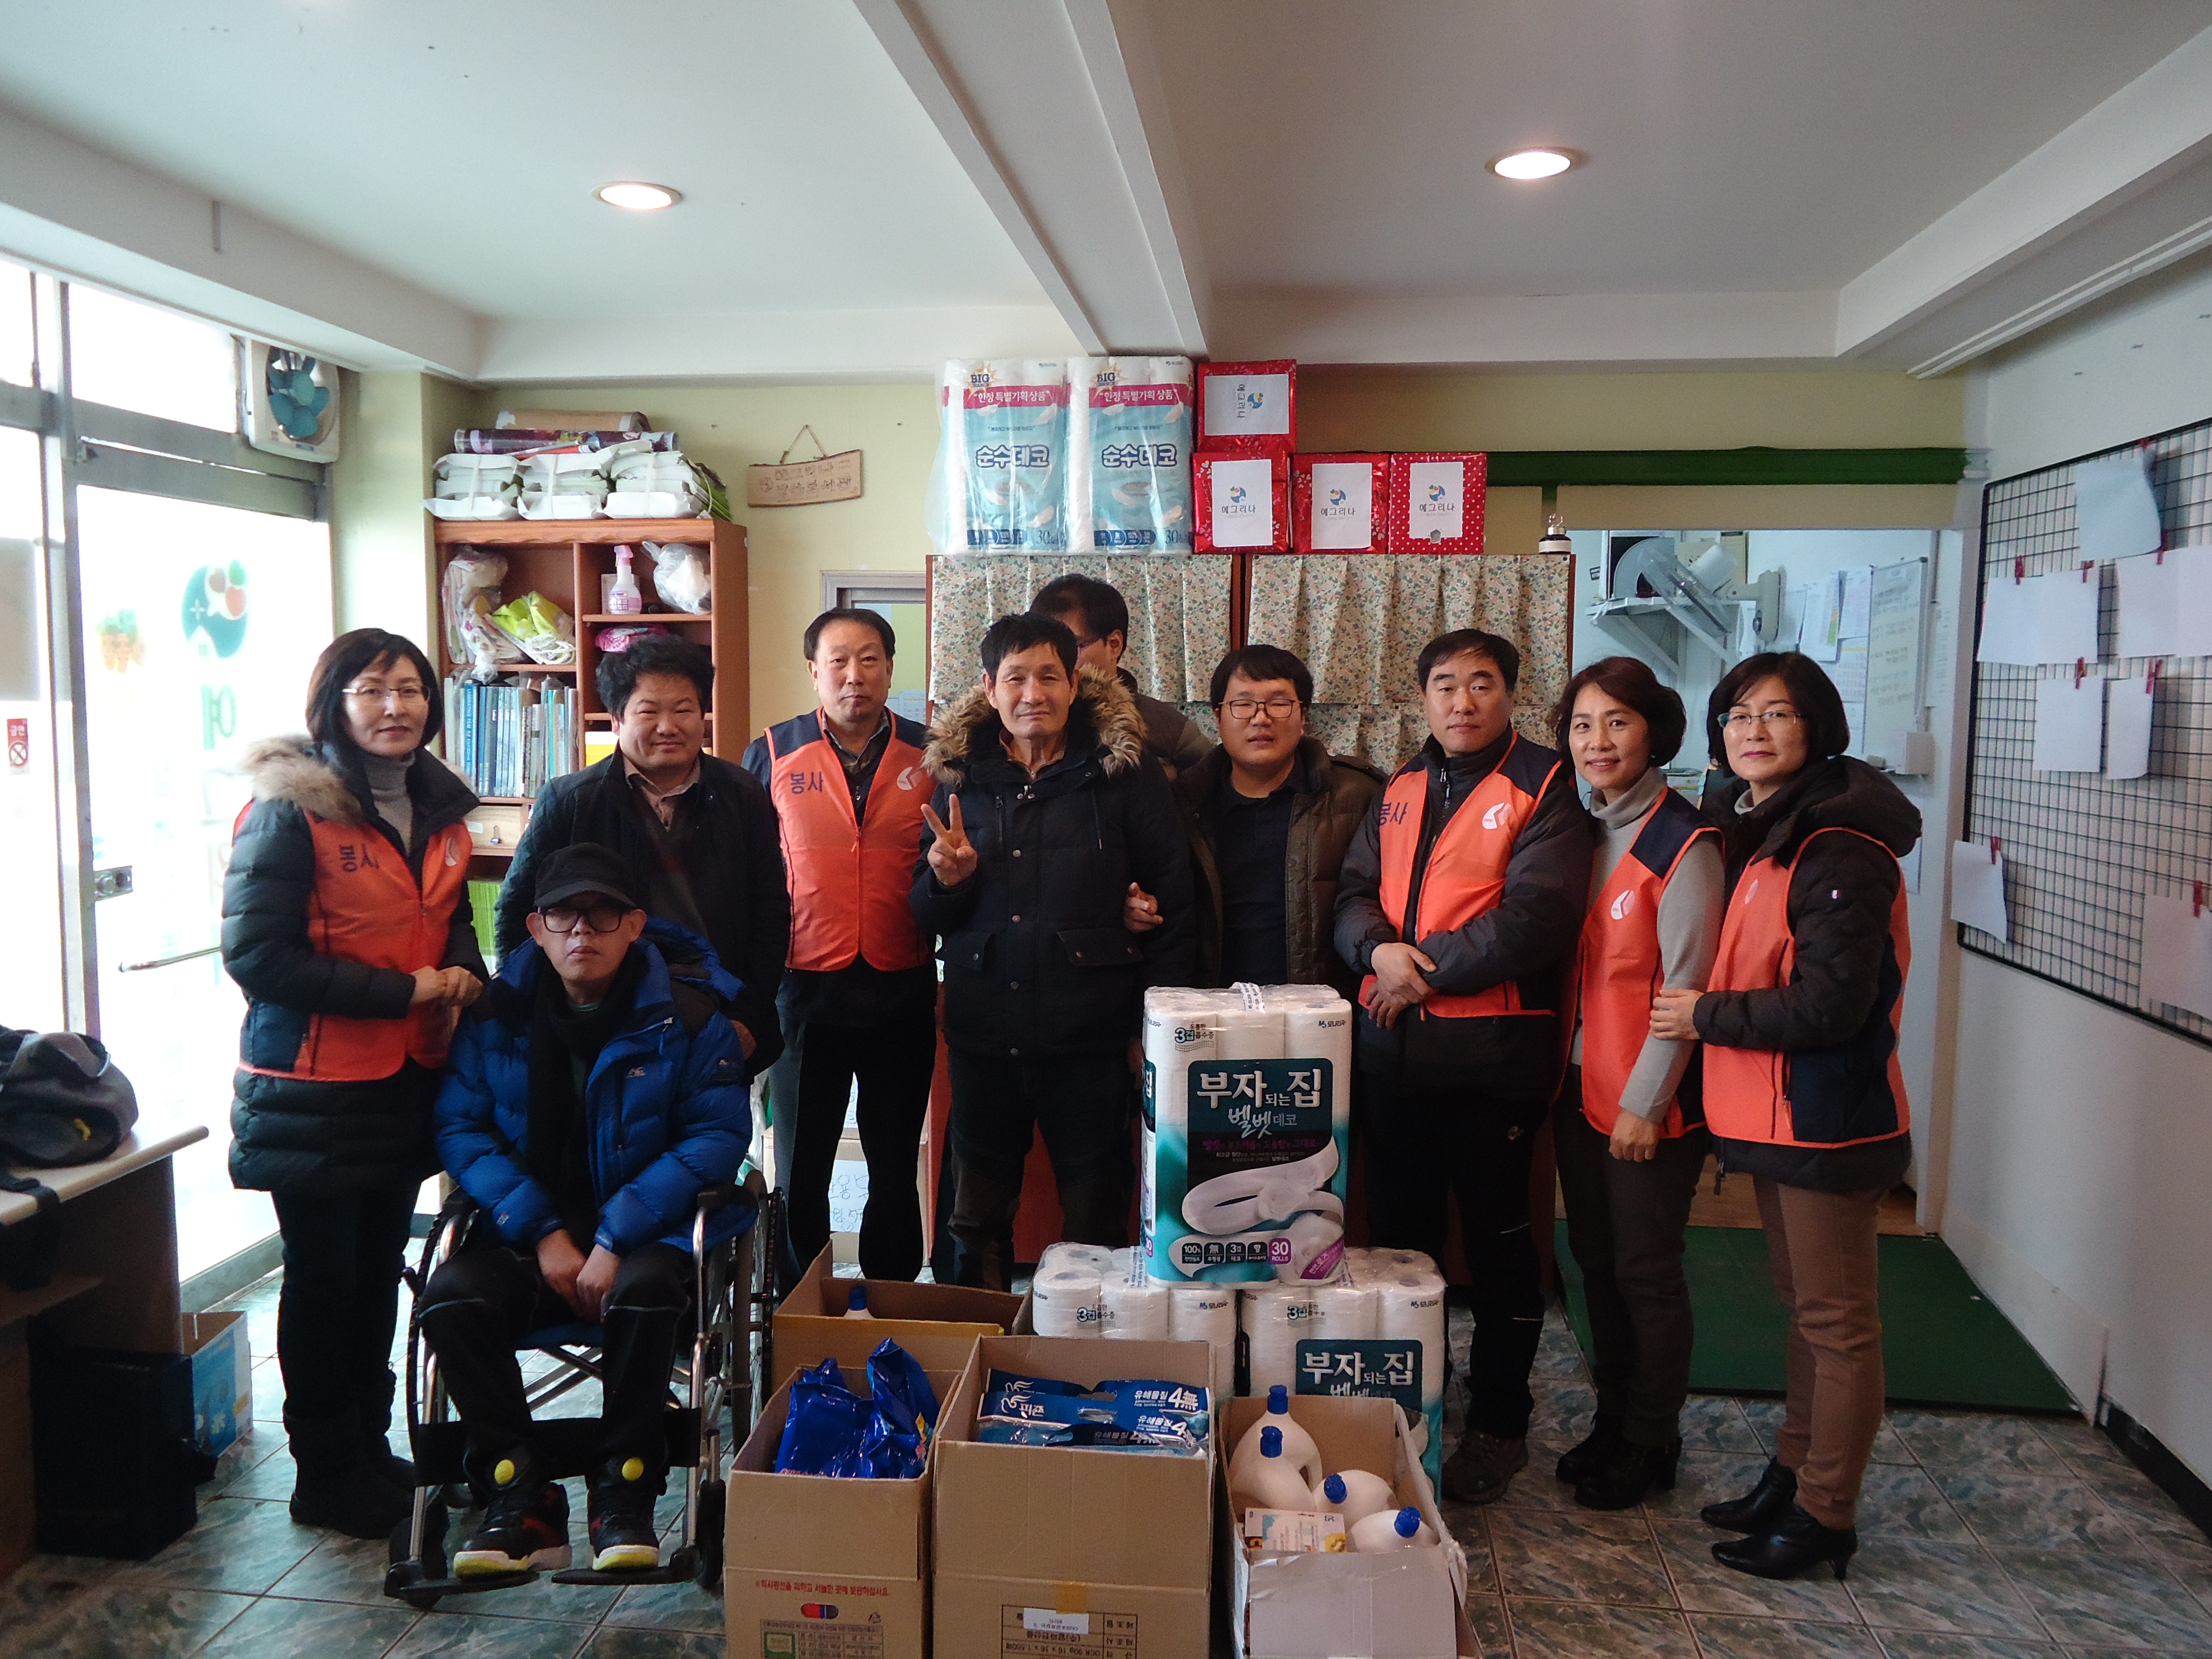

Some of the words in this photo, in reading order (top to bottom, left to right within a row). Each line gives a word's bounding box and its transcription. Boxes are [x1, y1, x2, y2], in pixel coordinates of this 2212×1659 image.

[970, 374, 990, 383] BIG
[1097, 372, 1116, 382] BIG
[995, 392, 1028, 402] 특별기획
[1122, 390, 1155, 401] 특별기획
[975, 444, 1050, 469] 순수데코
[1101, 443, 1177, 468] 순수데코
[790, 771, 824, 795] 봉사
[1380, 802, 1408, 825] 봉사
[339, 843, 379, 872] 봉사
[1175, 1027, 1195, 1044] 3겹
[1197, 1070, 1267, 1109] 부자
[1265, 1093, 1291, 1107] 되는
[1287, 1069, 1322, 1108] 집
[1228, 1104, 1272, 1139] 벨벳
[1273, 1114, 1298, 1126] 데코
[1209, 1244, 1219, 1254] 無
[1230, 1244, 1242, 1253] 3겹
[1253, 1244, 1261, 1253] 향
[1271, 1242, 1289, 1255] 30
[1302, 1352, 1366, 1385] 부자
[1363, 1372, 1387, 1385] 되는
[1383, 1351, 1414, 1386] 집
[1134, 1390, 1168, 1400] 유해물질
[1019, 1403, 1045, 1417] 피죤
[1137, 1415, 1173, 1427] 유해물질
